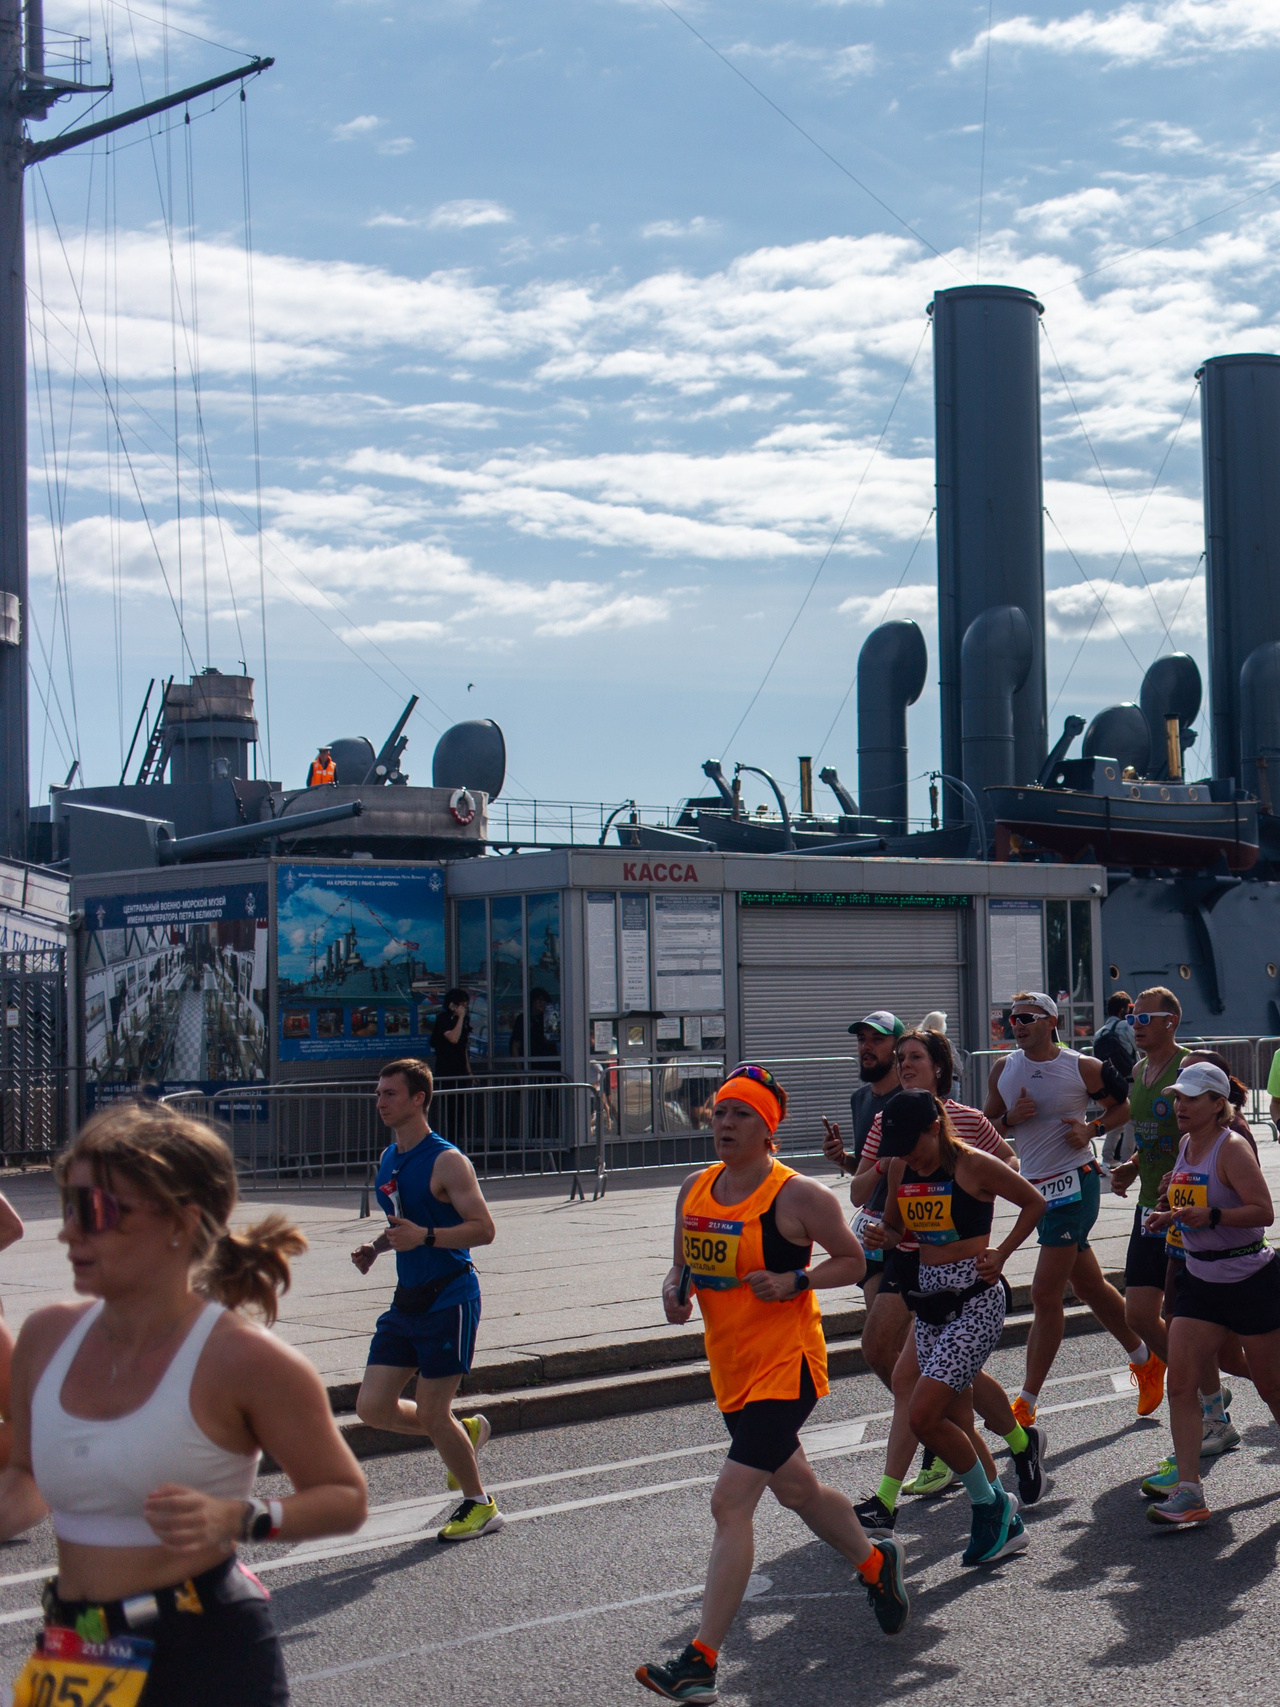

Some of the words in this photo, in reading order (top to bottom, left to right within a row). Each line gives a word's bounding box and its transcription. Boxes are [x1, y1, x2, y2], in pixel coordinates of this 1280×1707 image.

[623, 862, 699, 882] КАССА
[123, 902, 160, 914] ЦЕНТРАЛЬНЫЙ
[160, 898, 208, 911] ВОЕННО-МОРСКОЙ
[208, 895, 227, 907] МУЗЕЙ
[127, 914, 145, 924] ИМЕНИ
[146, 911, 178, 923] ИМПЕРАТОРА
[178, 911, 195, 921] ПЕТРА
[195, 908, 222, 920] ВЕЛИКОГО
[1040, 1175, 1074, 1197] 1709
[1173, 1189, 1196, 1207] 864
[907, 1200, 945, 1221] 6092
[708, 1221, 722, 1229] 21,1
[912, 1221, 942, 1229] ВАЛЕНТИНА
[684, 1236, 728, 1264] 3508
